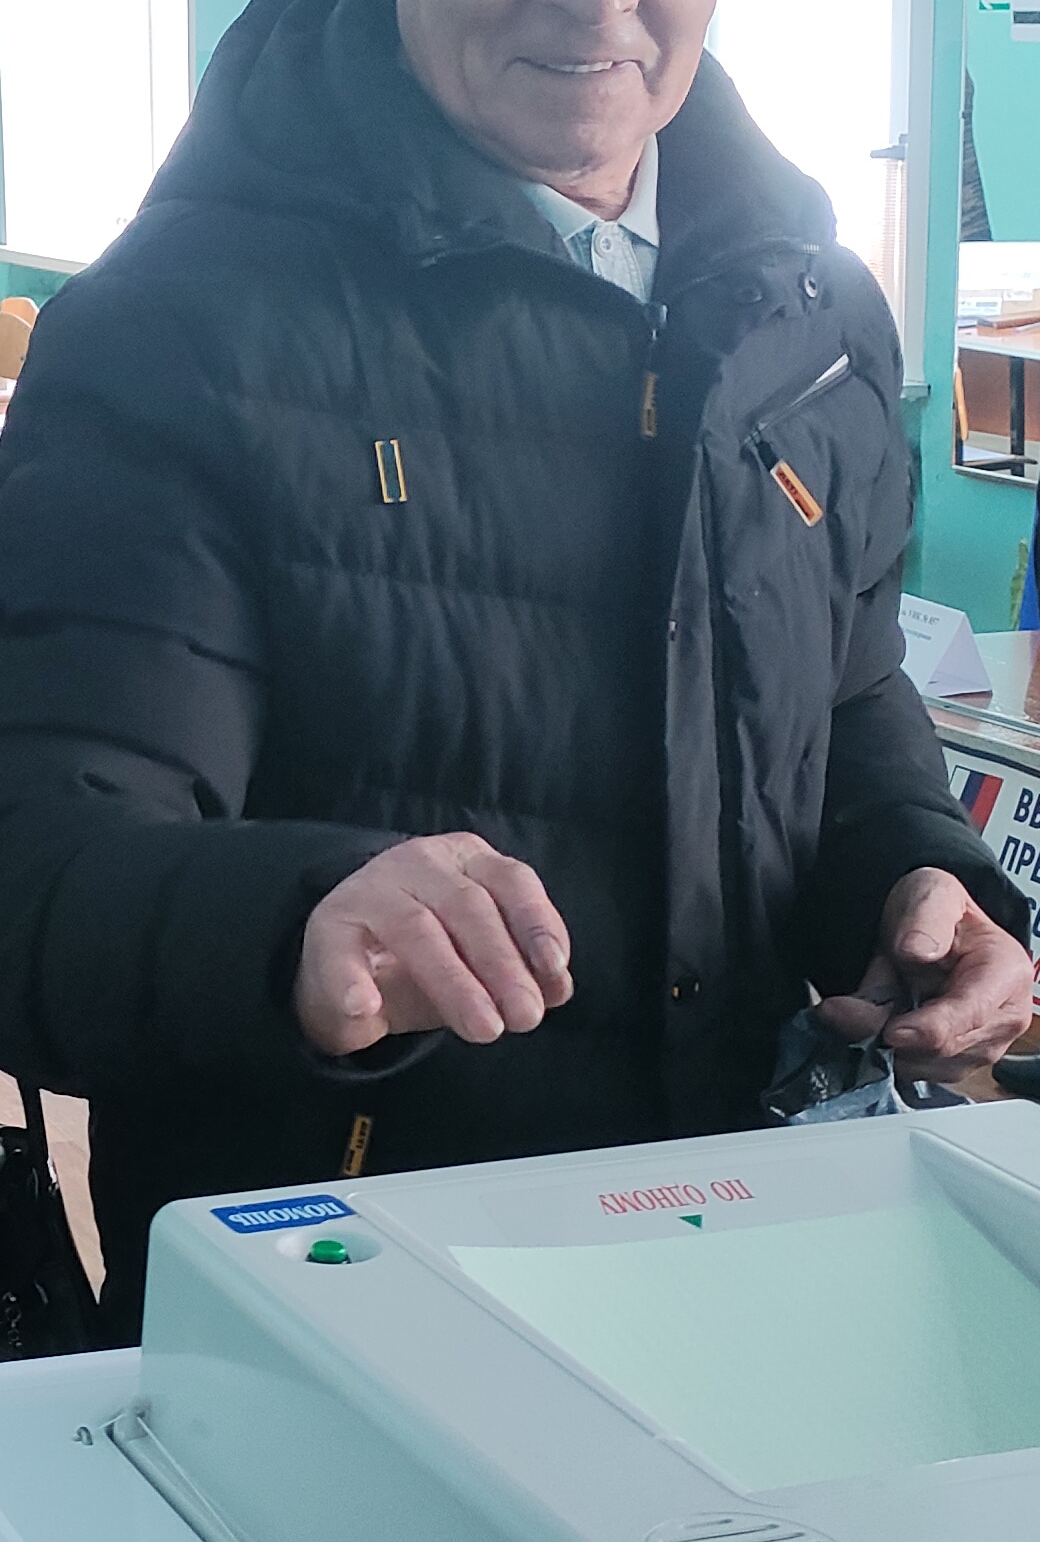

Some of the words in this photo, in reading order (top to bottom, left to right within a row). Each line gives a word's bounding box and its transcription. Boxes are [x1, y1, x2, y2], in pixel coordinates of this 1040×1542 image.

[598, 1182, 707, 1216] ОДНОМУ
[710, 1178, 756, 1202] ПО
[228, 1201, 345, 1227] ПОМОЩЬ
